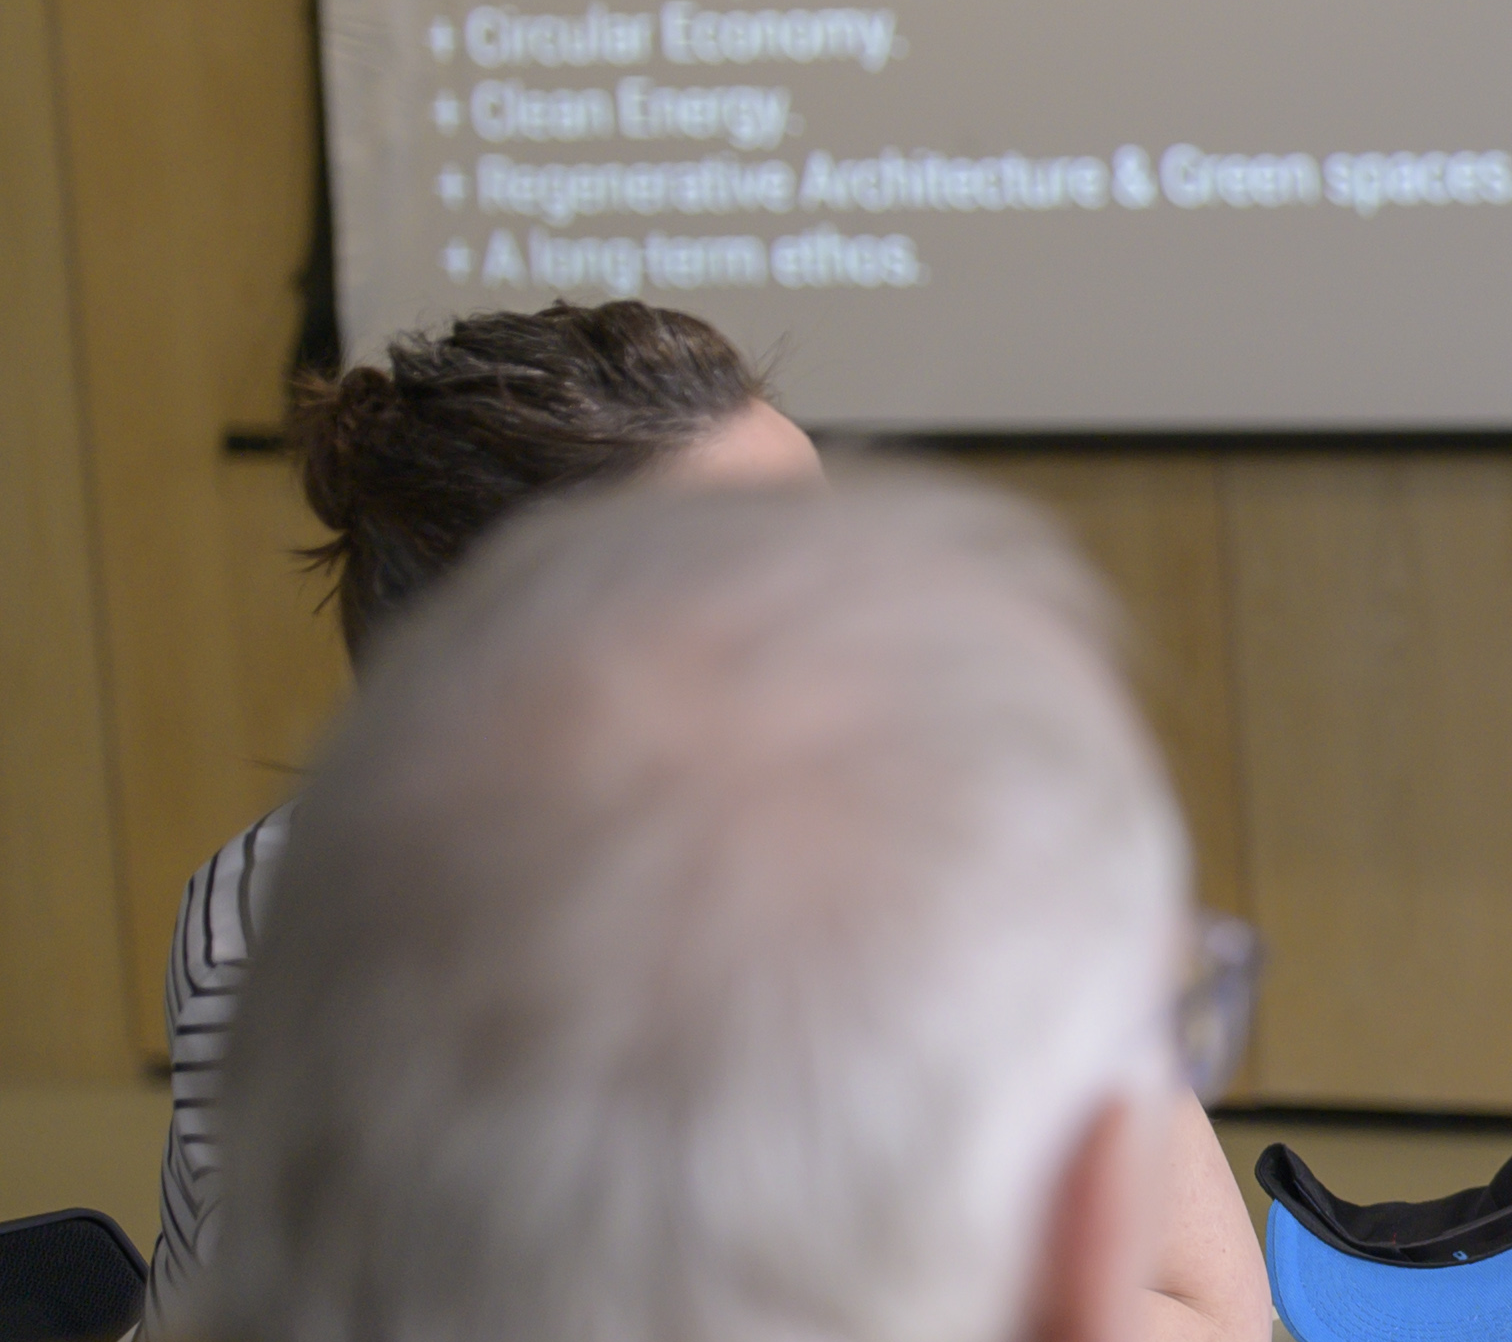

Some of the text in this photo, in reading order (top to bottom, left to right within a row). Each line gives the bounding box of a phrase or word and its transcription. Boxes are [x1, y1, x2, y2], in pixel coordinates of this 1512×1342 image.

[465, 0, 654, 68] Circular
[470, 78, 615, 142] Clean
[477, 151, 797, 227] Regenerative
[800, 145, 1109, 214] Architecture
[1111, 142, 1158, 211] &
[1160, 142, 1322, 209] Green
[482, 227, 527, 290] A
